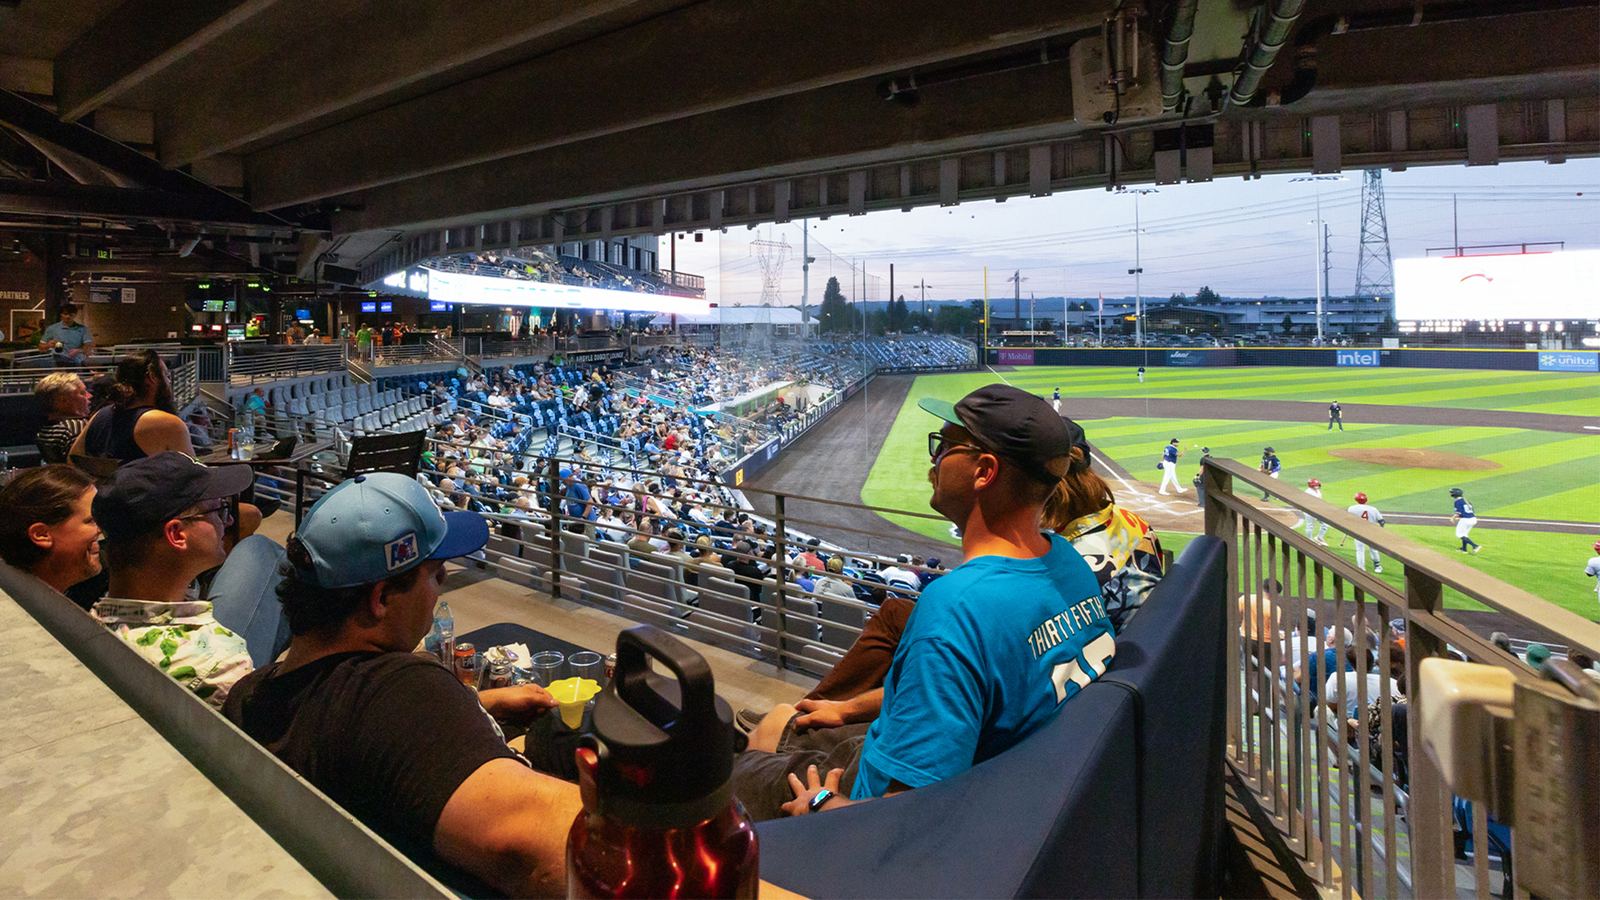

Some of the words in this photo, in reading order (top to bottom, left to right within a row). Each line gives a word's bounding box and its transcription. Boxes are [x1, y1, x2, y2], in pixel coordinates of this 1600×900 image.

[0, 291, 30, 300] PARTNERS
[1337, 350, 1377, 365] intel
[1558, 356, 1596, 365] unitus
[1361, 510, 1369, 521] 4
[1028, 611, 1075, 660] THIRTY
[1070, 595, 1106, 630] FIFTH
